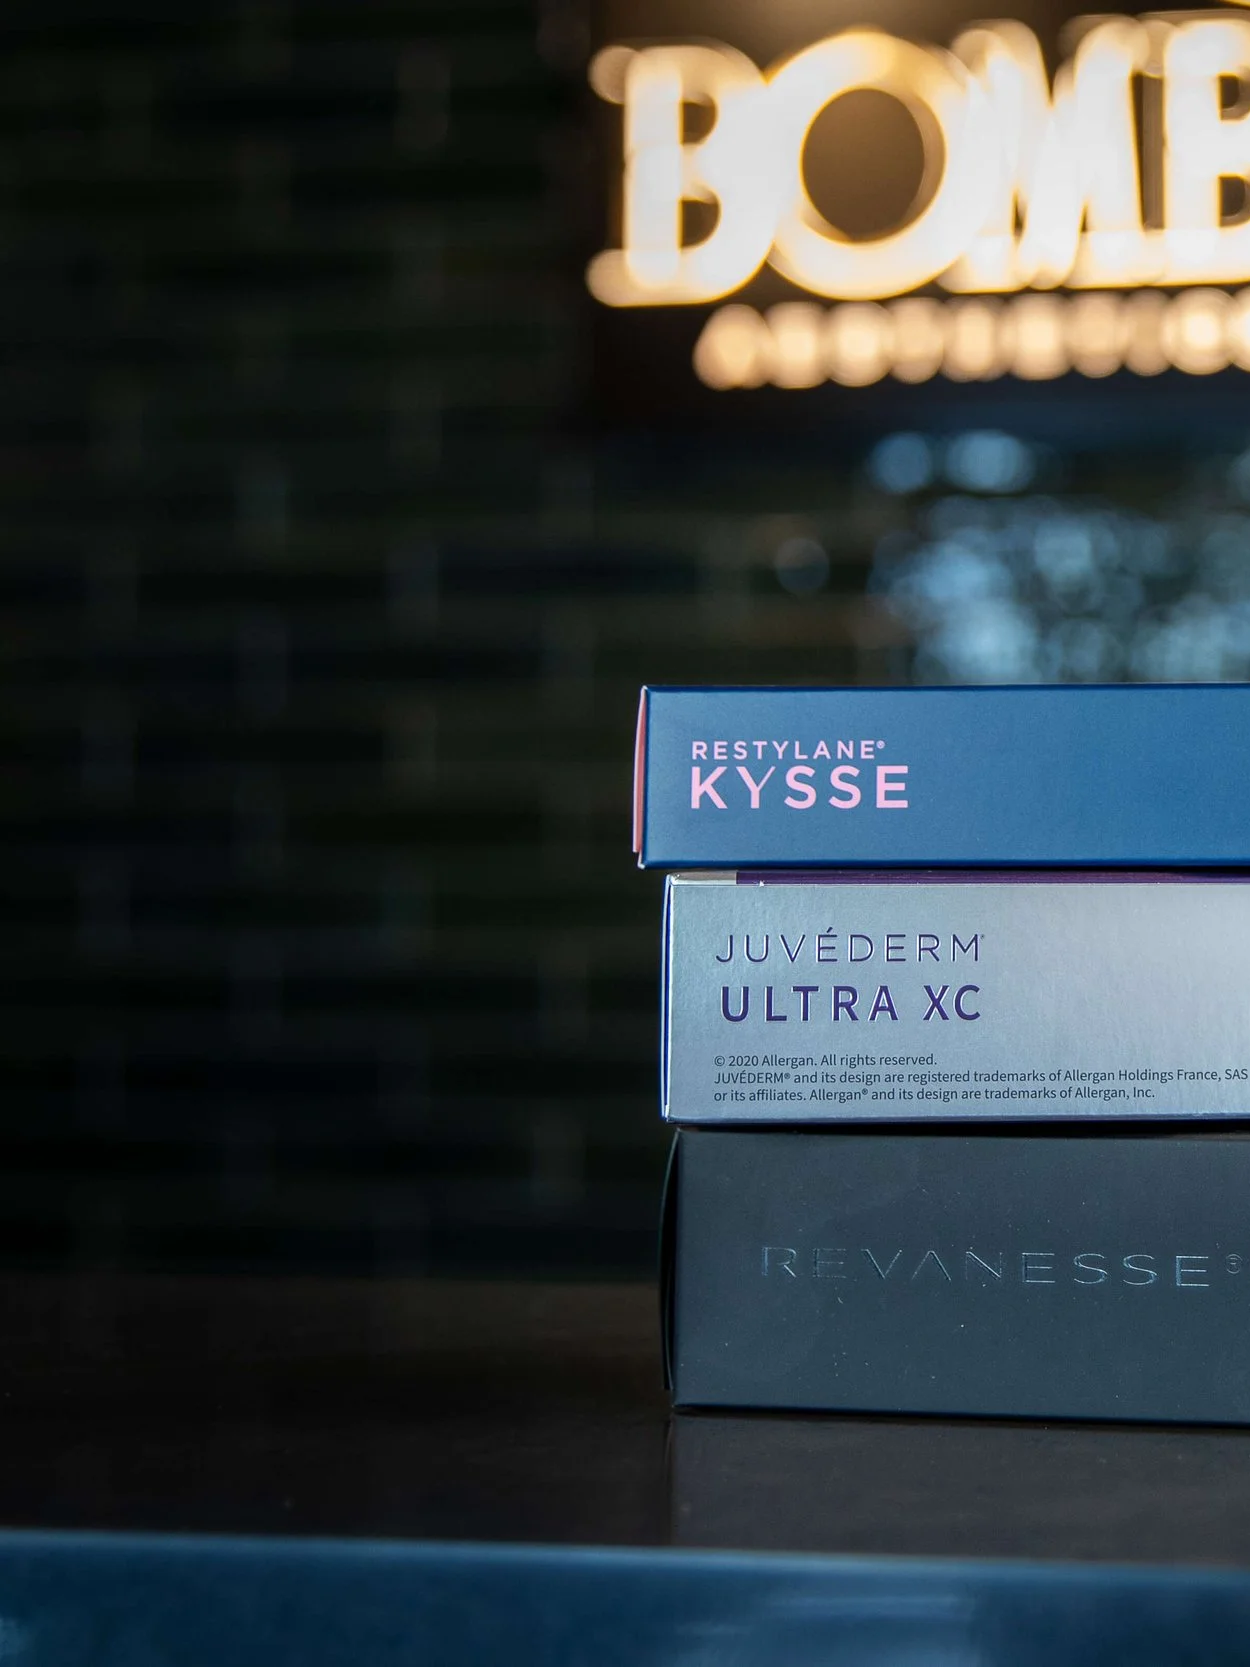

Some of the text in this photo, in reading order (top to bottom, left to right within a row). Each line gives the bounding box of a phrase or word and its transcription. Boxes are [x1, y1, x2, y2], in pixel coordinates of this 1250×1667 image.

[691, 740, 886, 760] RESTYLANE®
[690, 765, 909, 809] KYSSE
[720, 984, 981, 1022] ULTRA XC
[728, 1055, 759, 1067] 2020
[762, 1054, 818, 1069] Allergan.
[821, 1054, 837, 1066] All
[840, 1054, 876, 1069] rights
[879, 1053, 938, 1066] reserved.
[714, 1068, 1249, 1086] JUVÉDERM® and its design are registered trademarks of Allergan Holdings France, SAS
[713, 1086, 1155, 1103] or its affiliates. Allergan® and its design are trademarks of Allergan, Inc.
